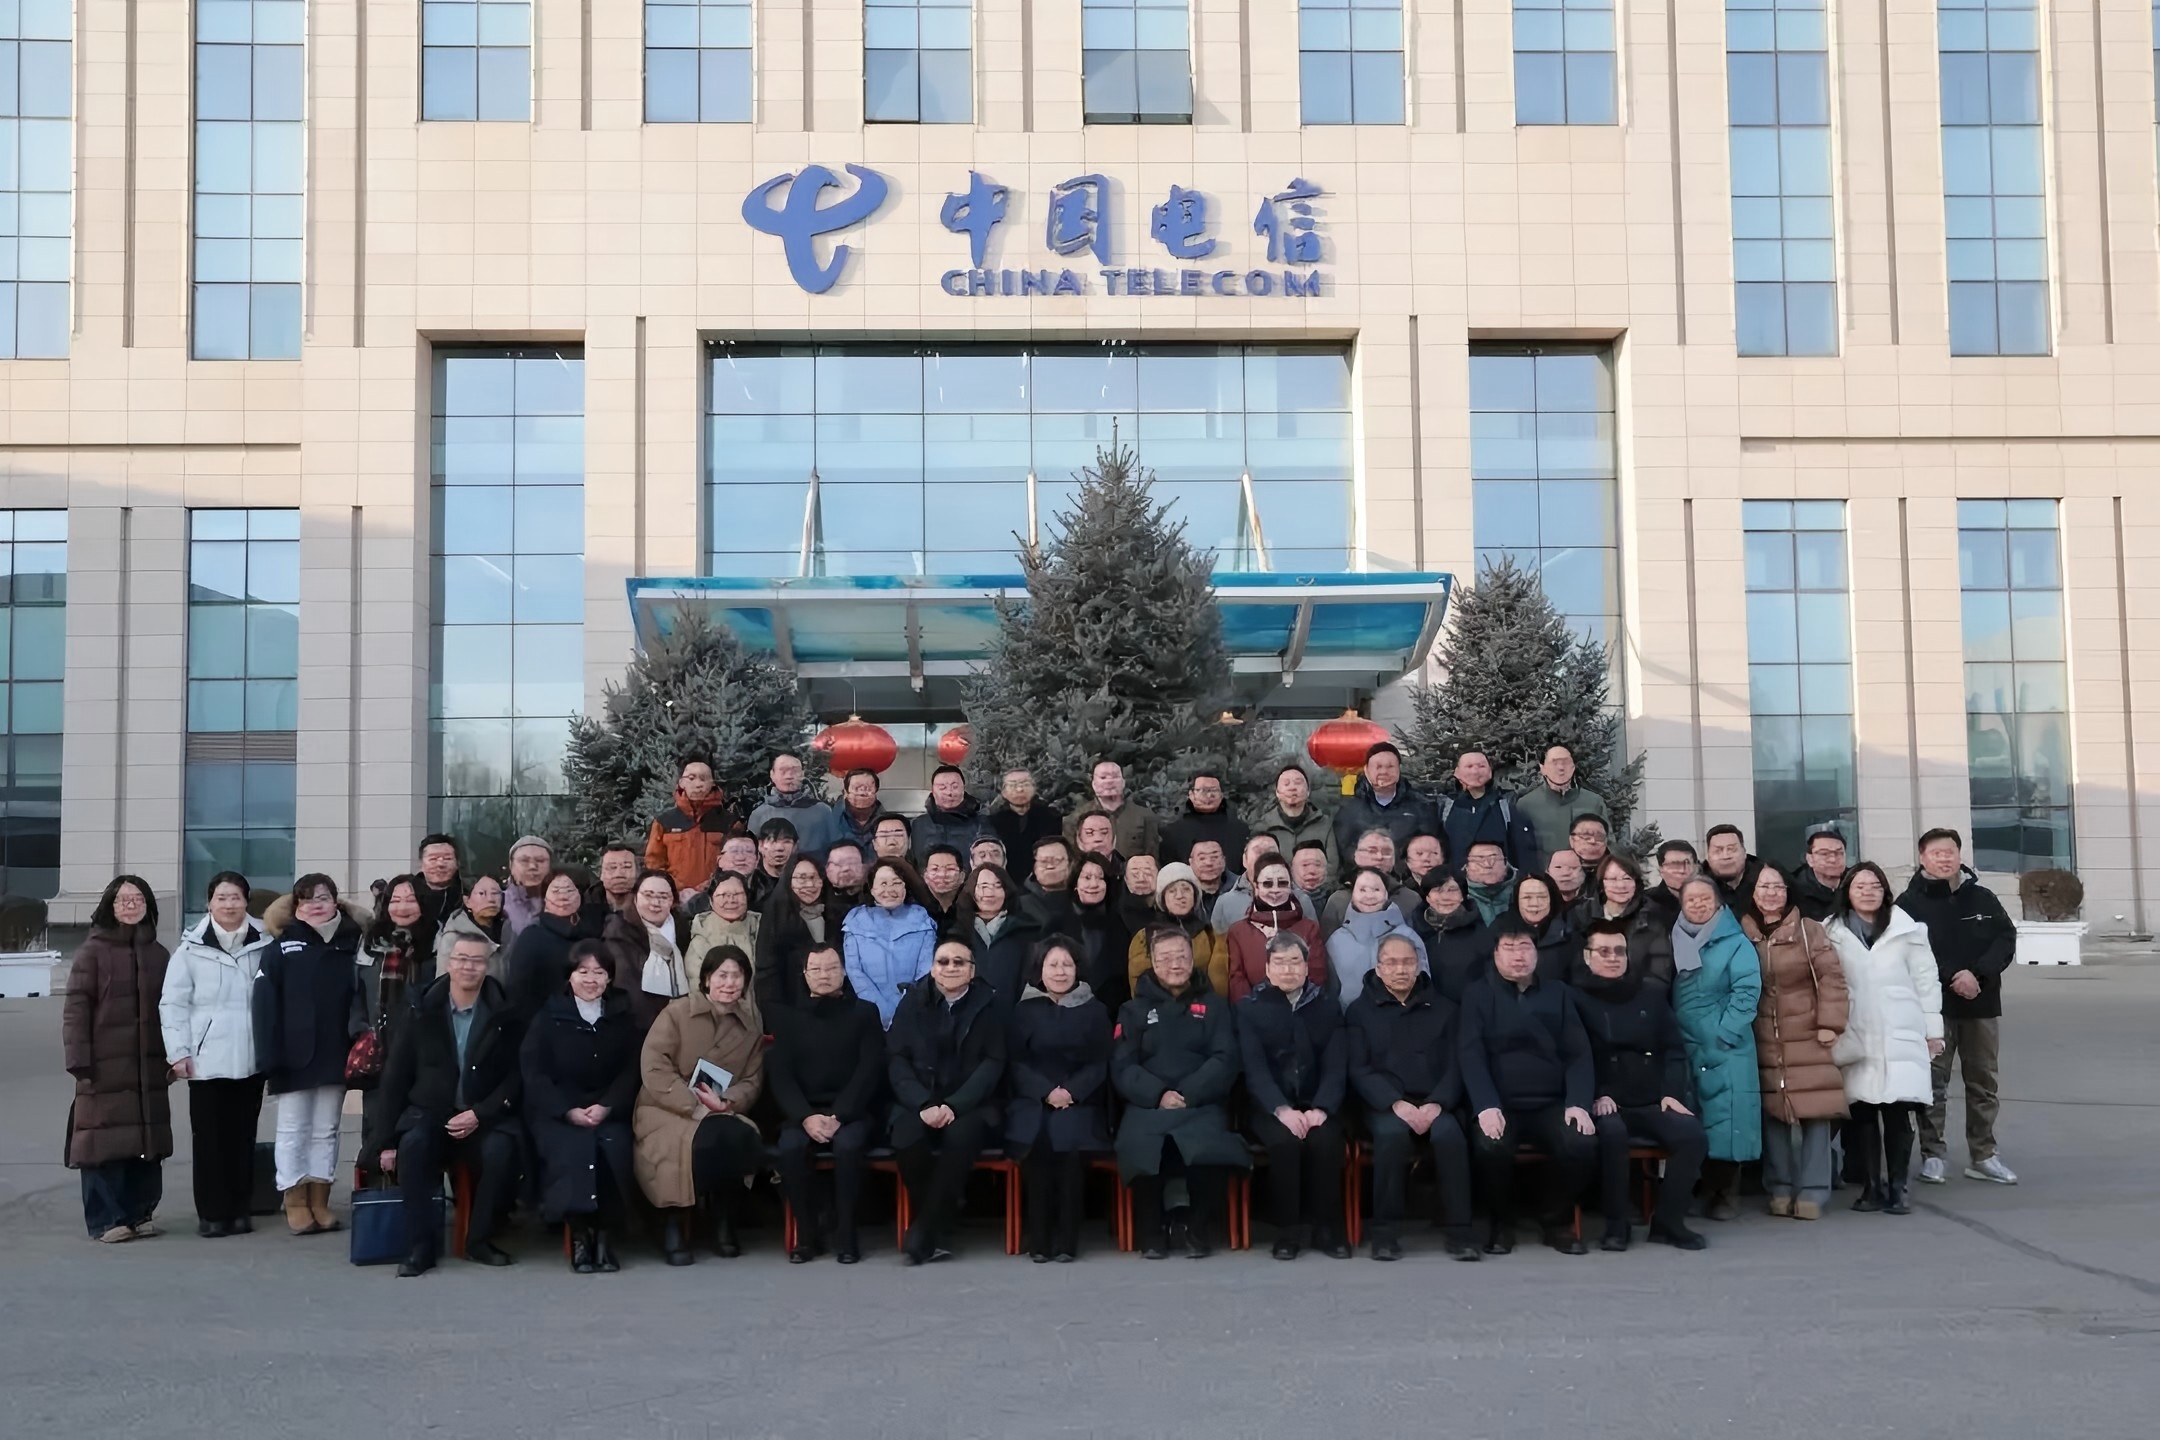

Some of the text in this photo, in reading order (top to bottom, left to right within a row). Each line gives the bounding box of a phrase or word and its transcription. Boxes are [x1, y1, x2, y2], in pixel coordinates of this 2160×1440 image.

[940, 170, 1321, 269] 中国电信
[941, 268, 1320, 297] CHINA TELECOM
